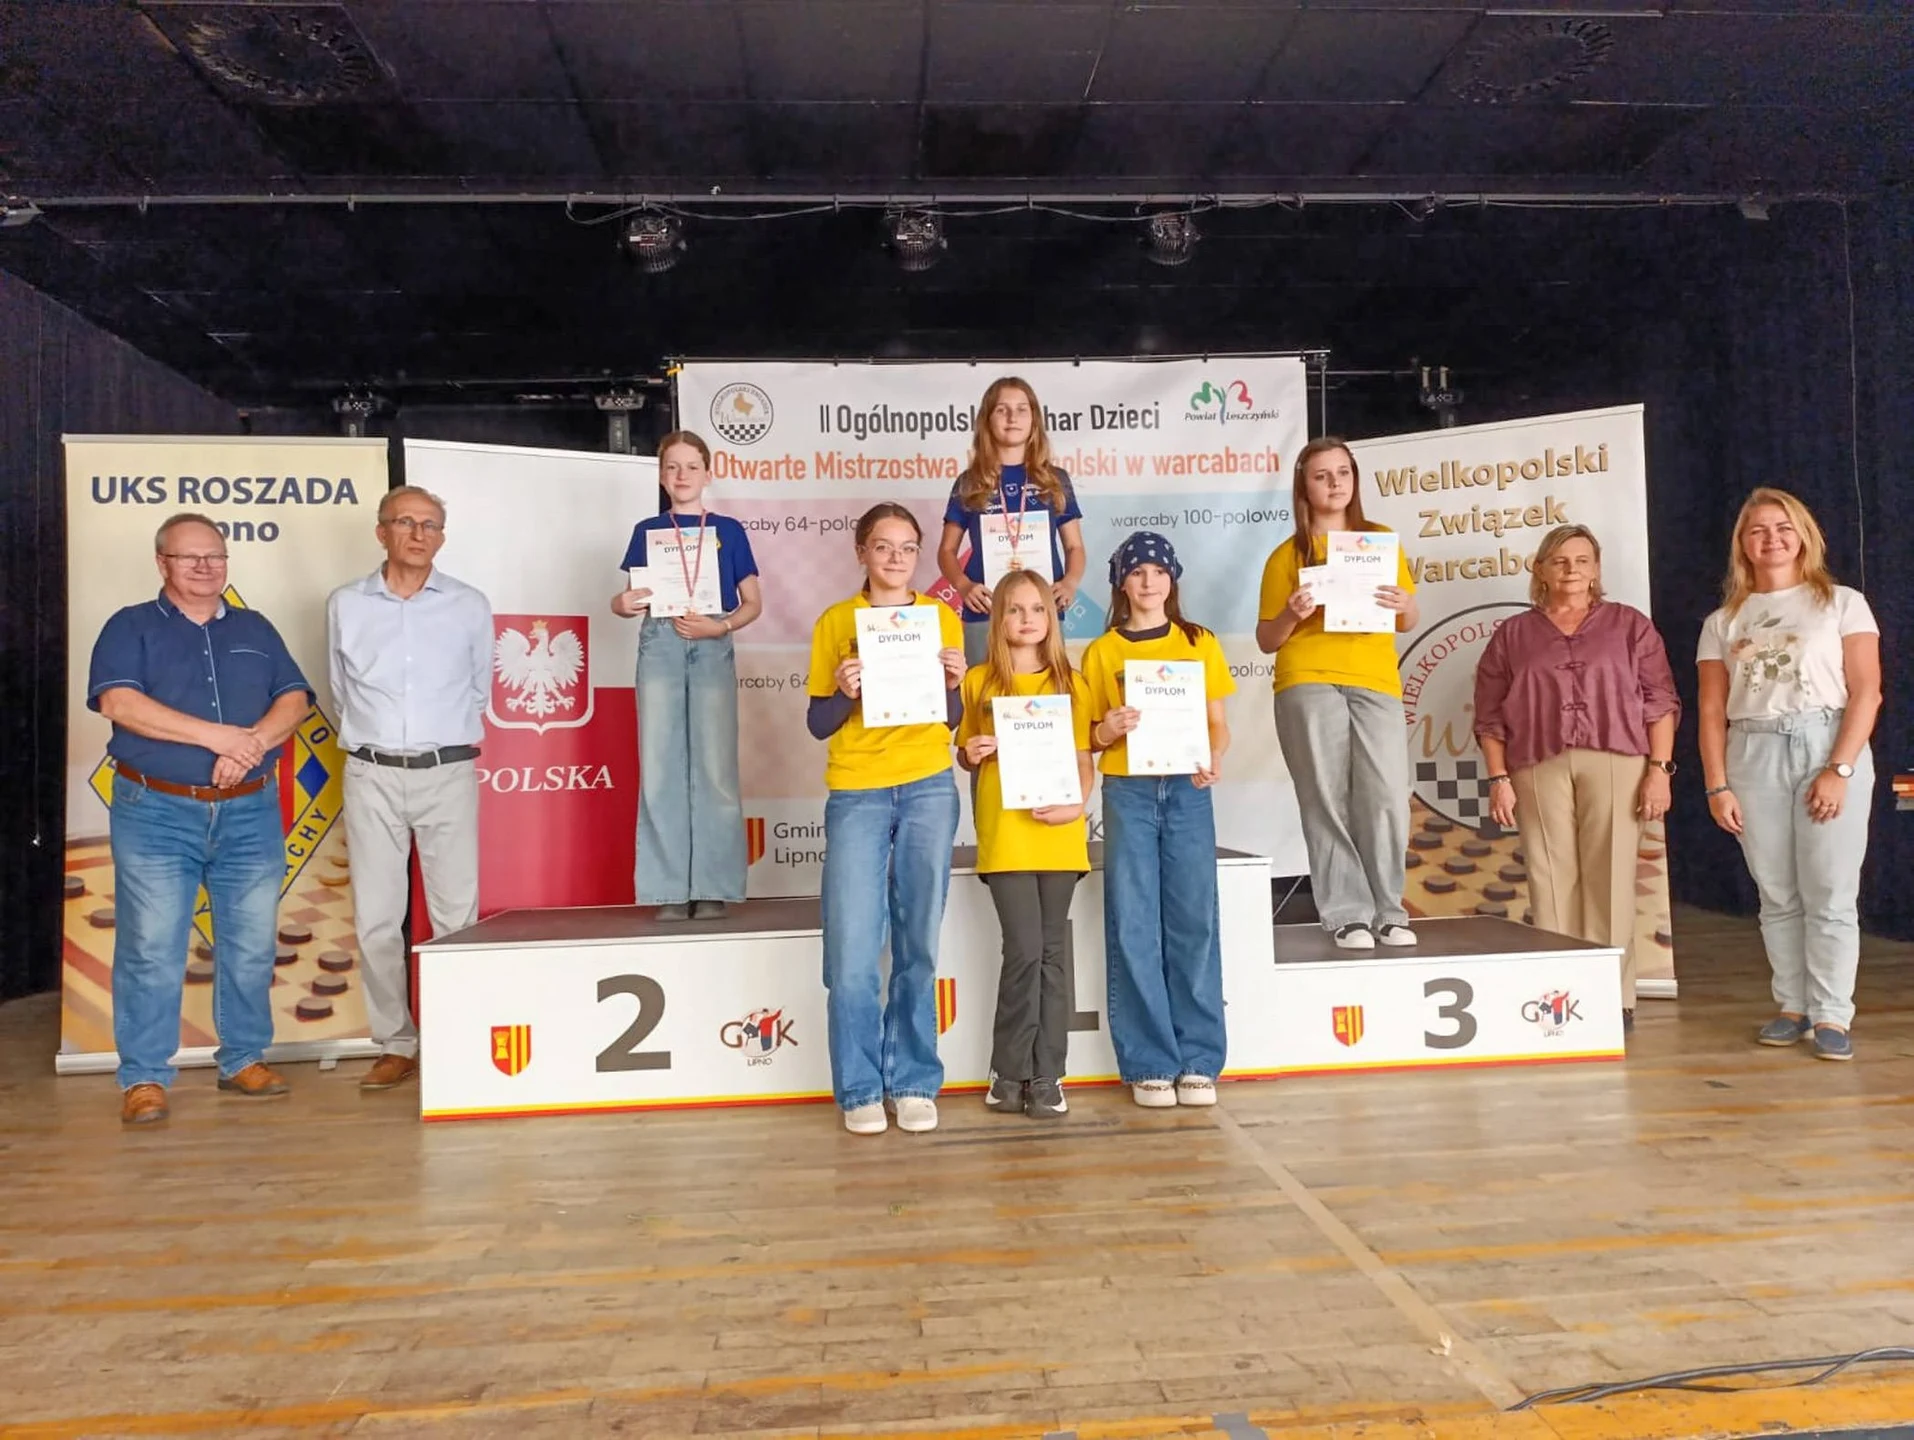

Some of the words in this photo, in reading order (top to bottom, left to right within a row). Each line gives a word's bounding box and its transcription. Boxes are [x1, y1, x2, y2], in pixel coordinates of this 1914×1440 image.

[820, 405, 830, 433] II
[1090, 401, 1160, 430] Dzieci
[1185, 412, 1217, 421] Powiat
[714, 450, 807, 480] Otwarte
[815, 451, 959, 480] Mistrzostwa
[1124, 454, 1145, 477] w
[1152, 445, 1280, 476] warcabach
[1374, 443, 1610, 497] Wielkopolski
[91, 476, 168, 505] UKS
[178, 477, 359, 505] ROSZADA
[1110, 513, 1179, 528] warcaby
[1184, 508, 1290, 530] 100-polowe
[1418, 495, 1570, 538] Związek
[1344, 555, 1381, 563] DYPLOM
[878, 633, 921, 643] DYPLOM
[1145, 687, 1186, 696] DYPLOM
[1013, 721, 1053, 730] DYPLOM
[595, 973, 672, 1073] 2
[1423, 977, 1478, 1050] 3
